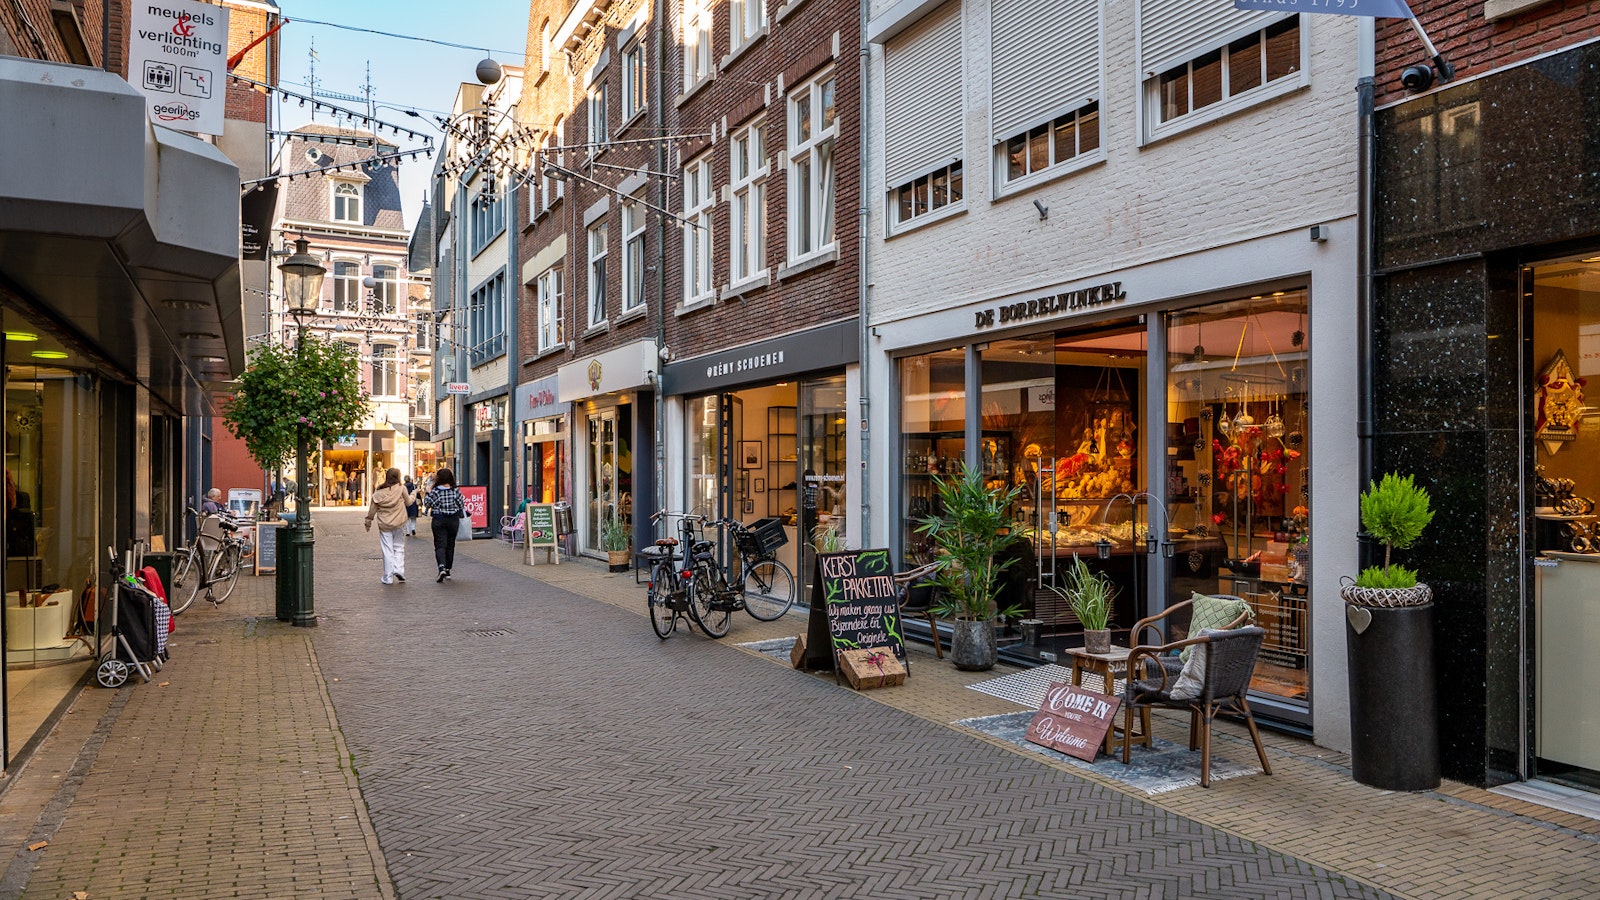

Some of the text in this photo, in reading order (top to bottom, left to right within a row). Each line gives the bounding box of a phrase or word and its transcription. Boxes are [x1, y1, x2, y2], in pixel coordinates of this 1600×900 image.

[148, 5, 214, 26] meubels
[172, 15, 196, 37] &
[138, 29, 222, 55] verlichting
[153, 104, 200, 120] geerlings
[974, 281, 1127, 328] DE BORRELWINKEL
[737, 350, 784, 372] SCHOENEN
[471, 494, 484, 502] BH
[822, 555, 858, 578] KERST
[842, 576, 895, 600] PAKKETTEN
[840, 603, 862, 616] maken
[863, 604, 883, 620] graag
[857, 630, 888, 648] Originele
[1048, 686, 1112, 720] COME IN
[1035, 717, 1088, 749] Welcome
